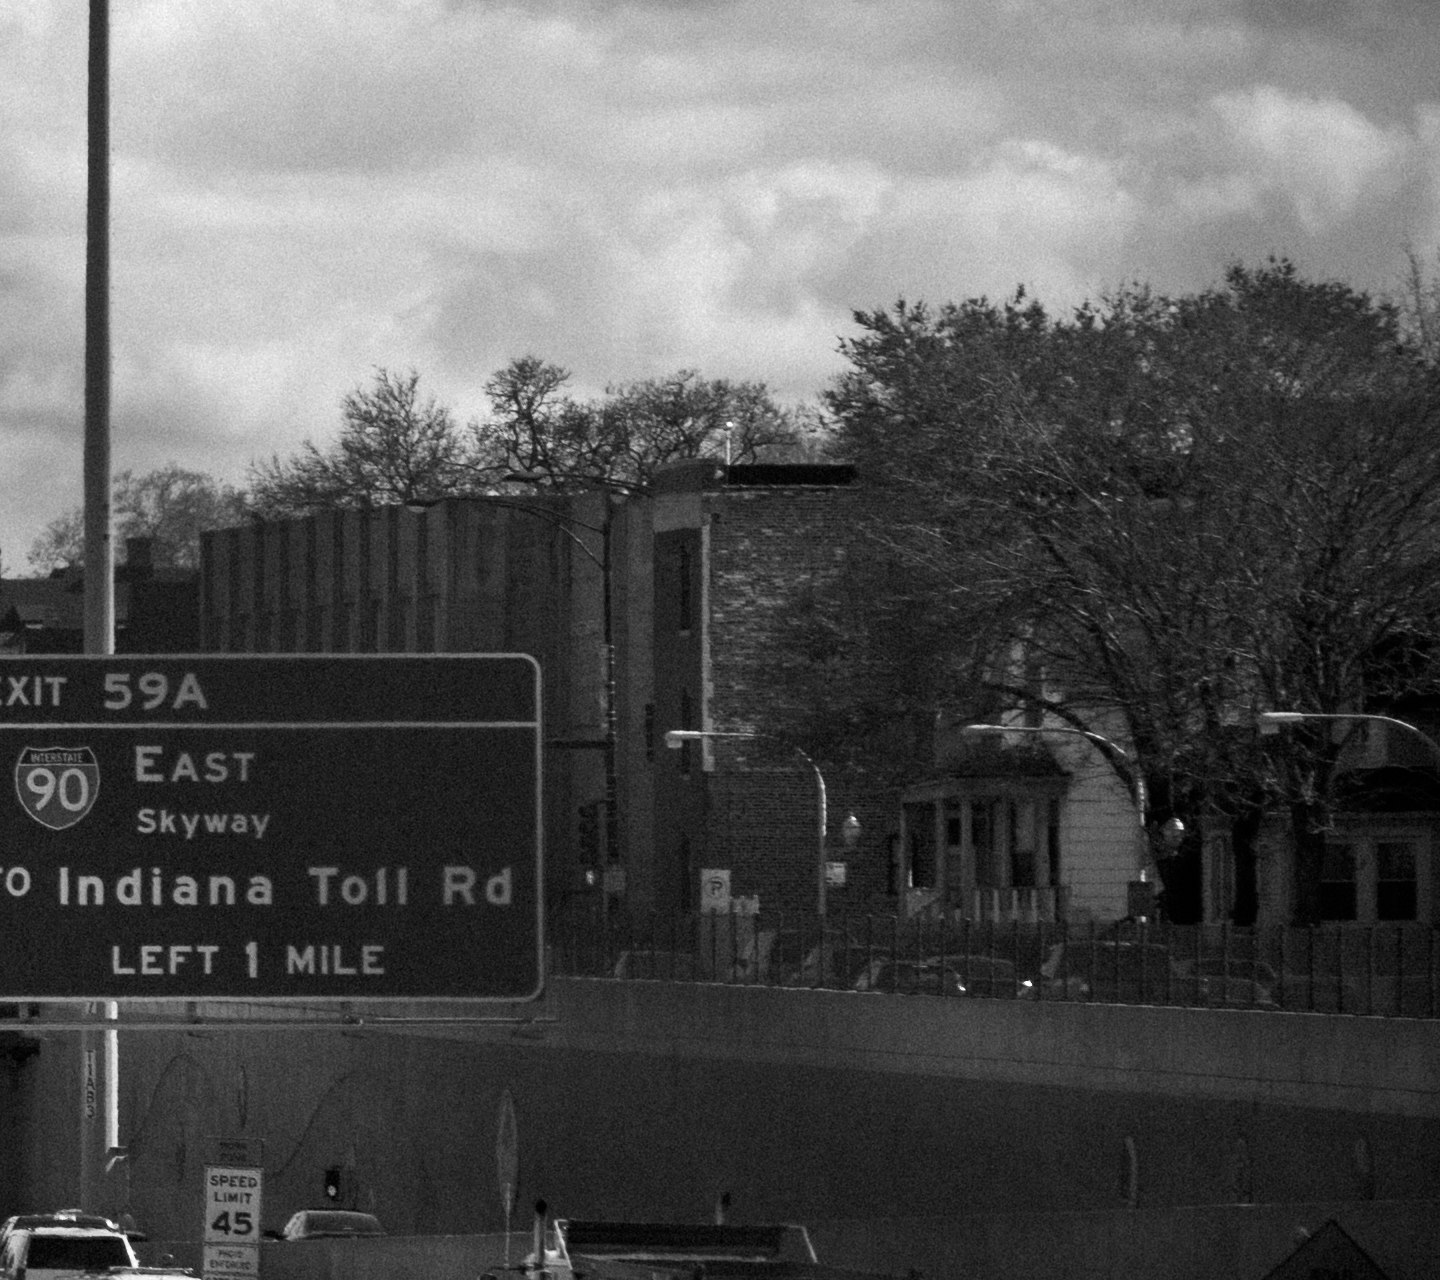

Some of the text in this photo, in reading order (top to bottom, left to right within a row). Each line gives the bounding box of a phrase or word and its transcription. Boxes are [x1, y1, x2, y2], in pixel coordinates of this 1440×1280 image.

[103, 672, 208, 710] 59A
[30, 751, 84, 764] INTERSTATE
[135, 745, 256, 783] EAST
[25, 768, 89, 812] 90
[137, 807, 271, 840] Skyway
[59, 866, 274, 906] Indiana
[309, 867, 408, 906] Toll
[443, 866, 512, 906] Rd
[111, 942, 386, 978] LEFT 1 MILE
[210, 1175, 258, 1189] SPEED
[214, 1191, 253, 1204] LIMIT
[212, 1211, 254, 1236] 45
